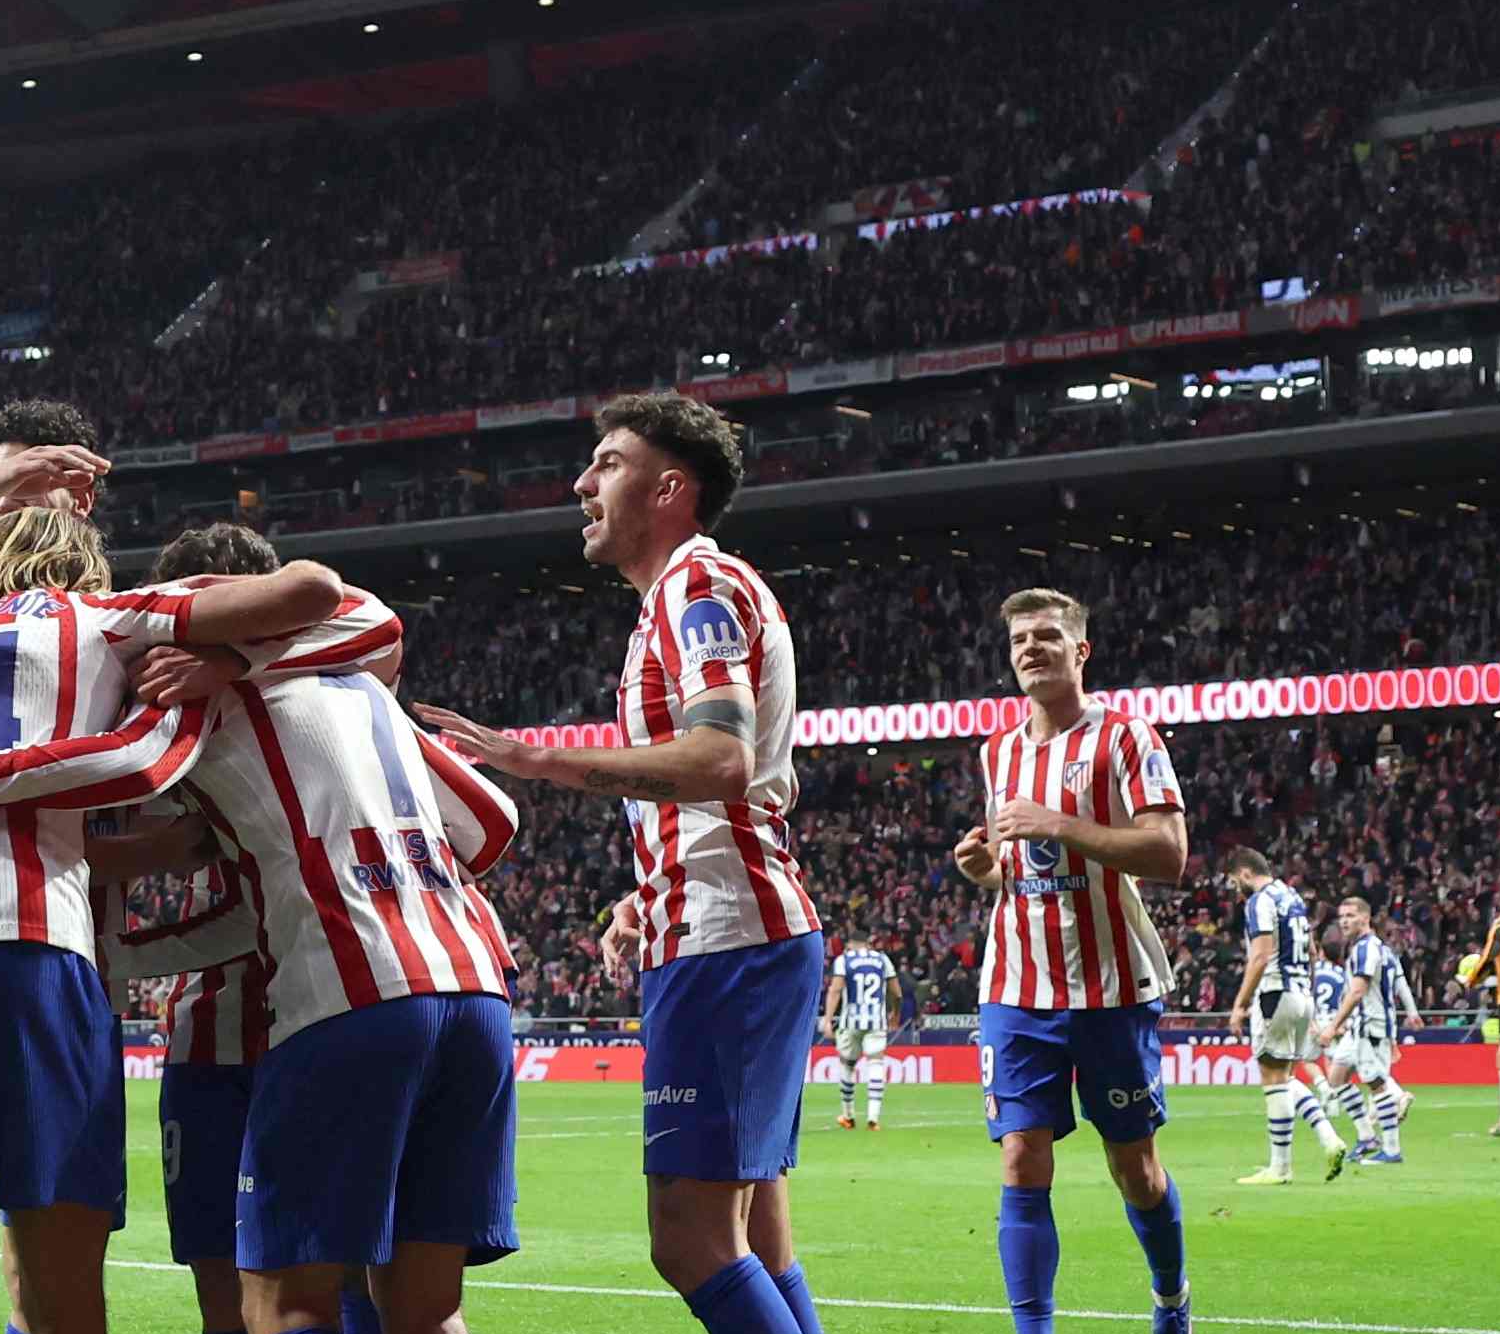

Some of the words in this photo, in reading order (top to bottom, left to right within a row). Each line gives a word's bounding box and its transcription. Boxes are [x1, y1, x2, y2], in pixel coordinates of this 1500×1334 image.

[687, 644, 742, 666] kraken
[1062, 875, 1087, 892] AIR
[852, 972, 881, 1005] 12
[1314, 982, 1333, 1009] 2
[981, 1044, 996, 1088] 9
[643, 1084, 697, 1105] mAve
